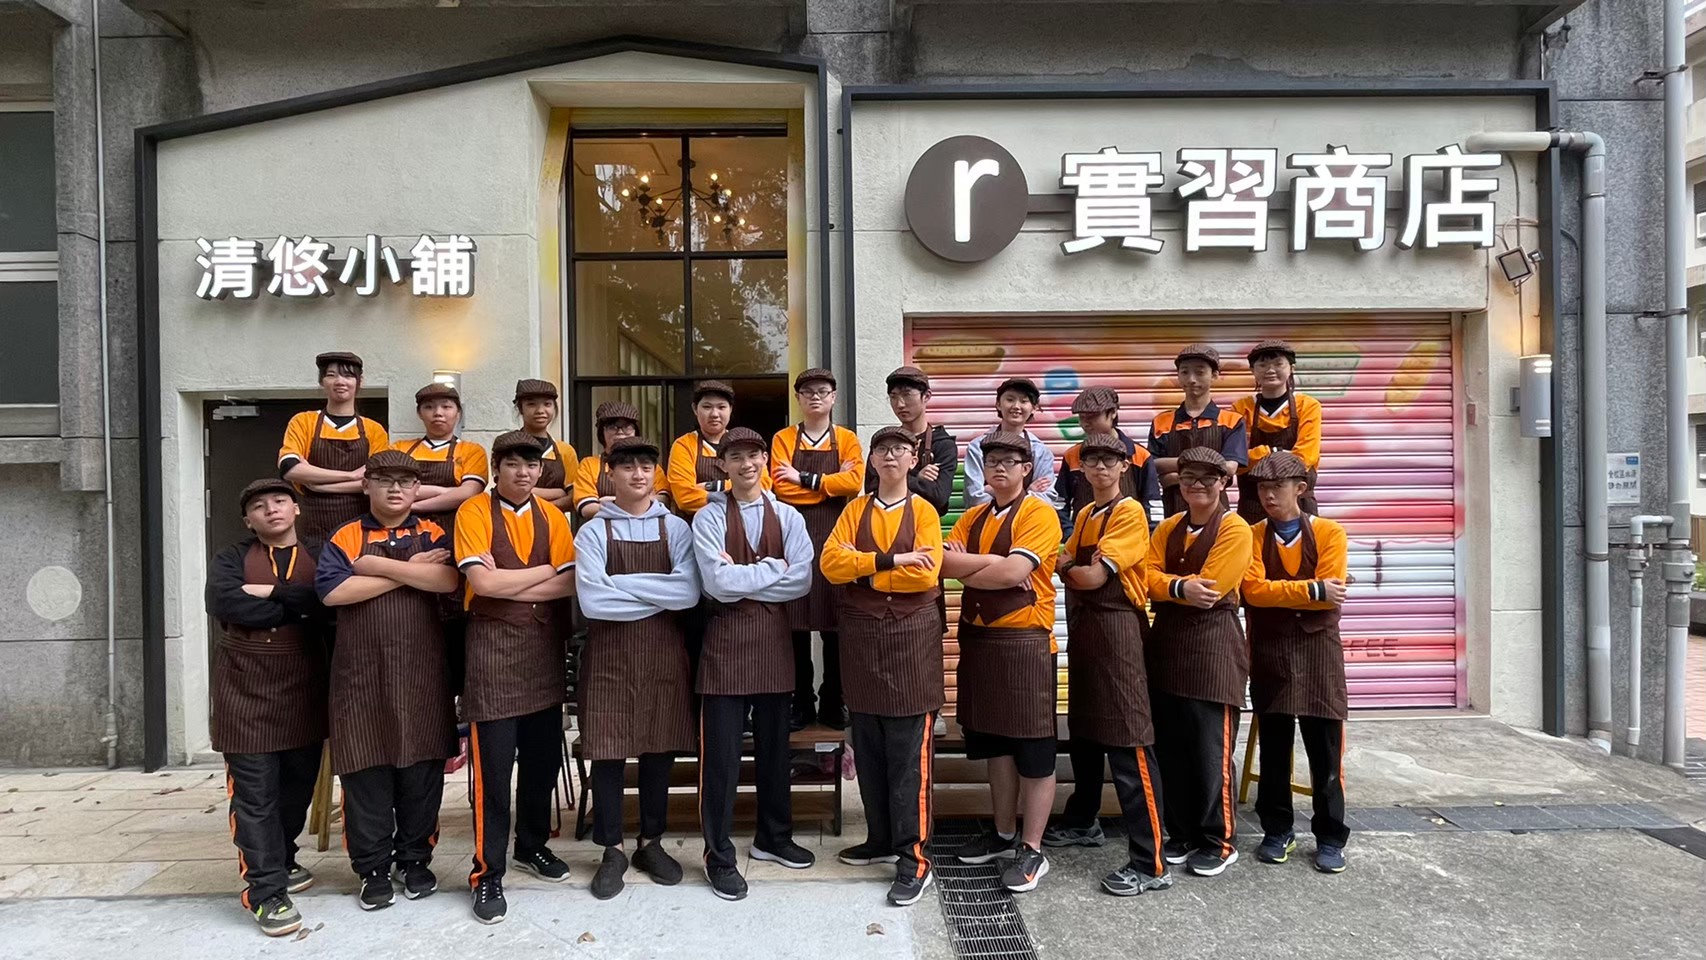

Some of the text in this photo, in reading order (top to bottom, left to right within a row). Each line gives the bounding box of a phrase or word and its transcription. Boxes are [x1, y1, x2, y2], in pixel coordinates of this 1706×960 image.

[954, 159, 1000, 242] r
[1060, 145, 1503, 254] 實習商店
[195, 234, 476, 299] 清悠小舖
